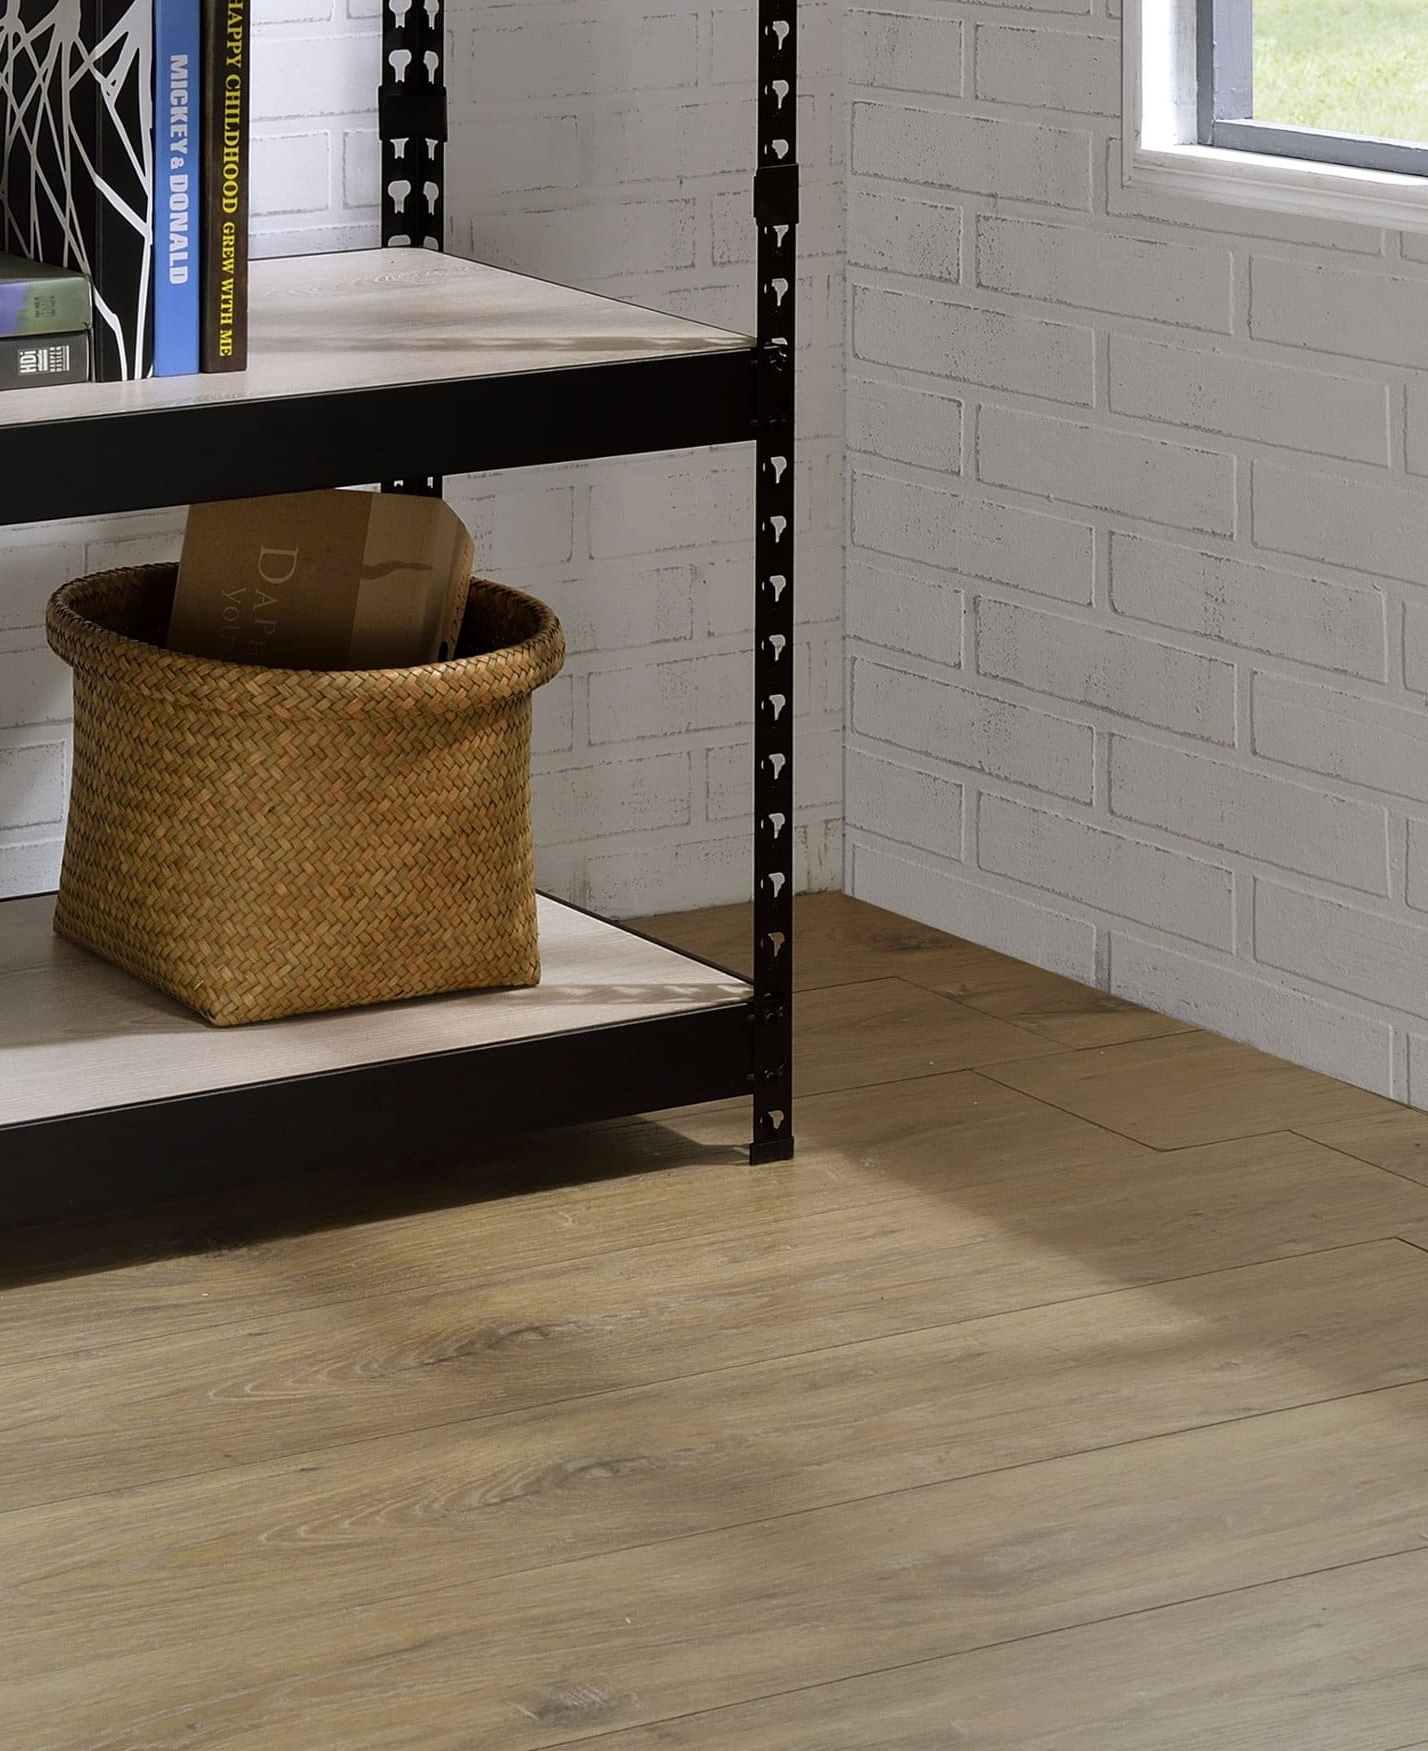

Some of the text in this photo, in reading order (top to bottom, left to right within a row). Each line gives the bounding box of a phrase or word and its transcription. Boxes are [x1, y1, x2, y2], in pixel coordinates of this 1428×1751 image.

[169, 54, 189, 285] MICKEY & DONALD
[222, 73, 242, 214] CHILDHOOD
[221, 221, 236, 274] GREW
[220, 278, 234, 325] WITH
[219, 330, 233, 357] ME
